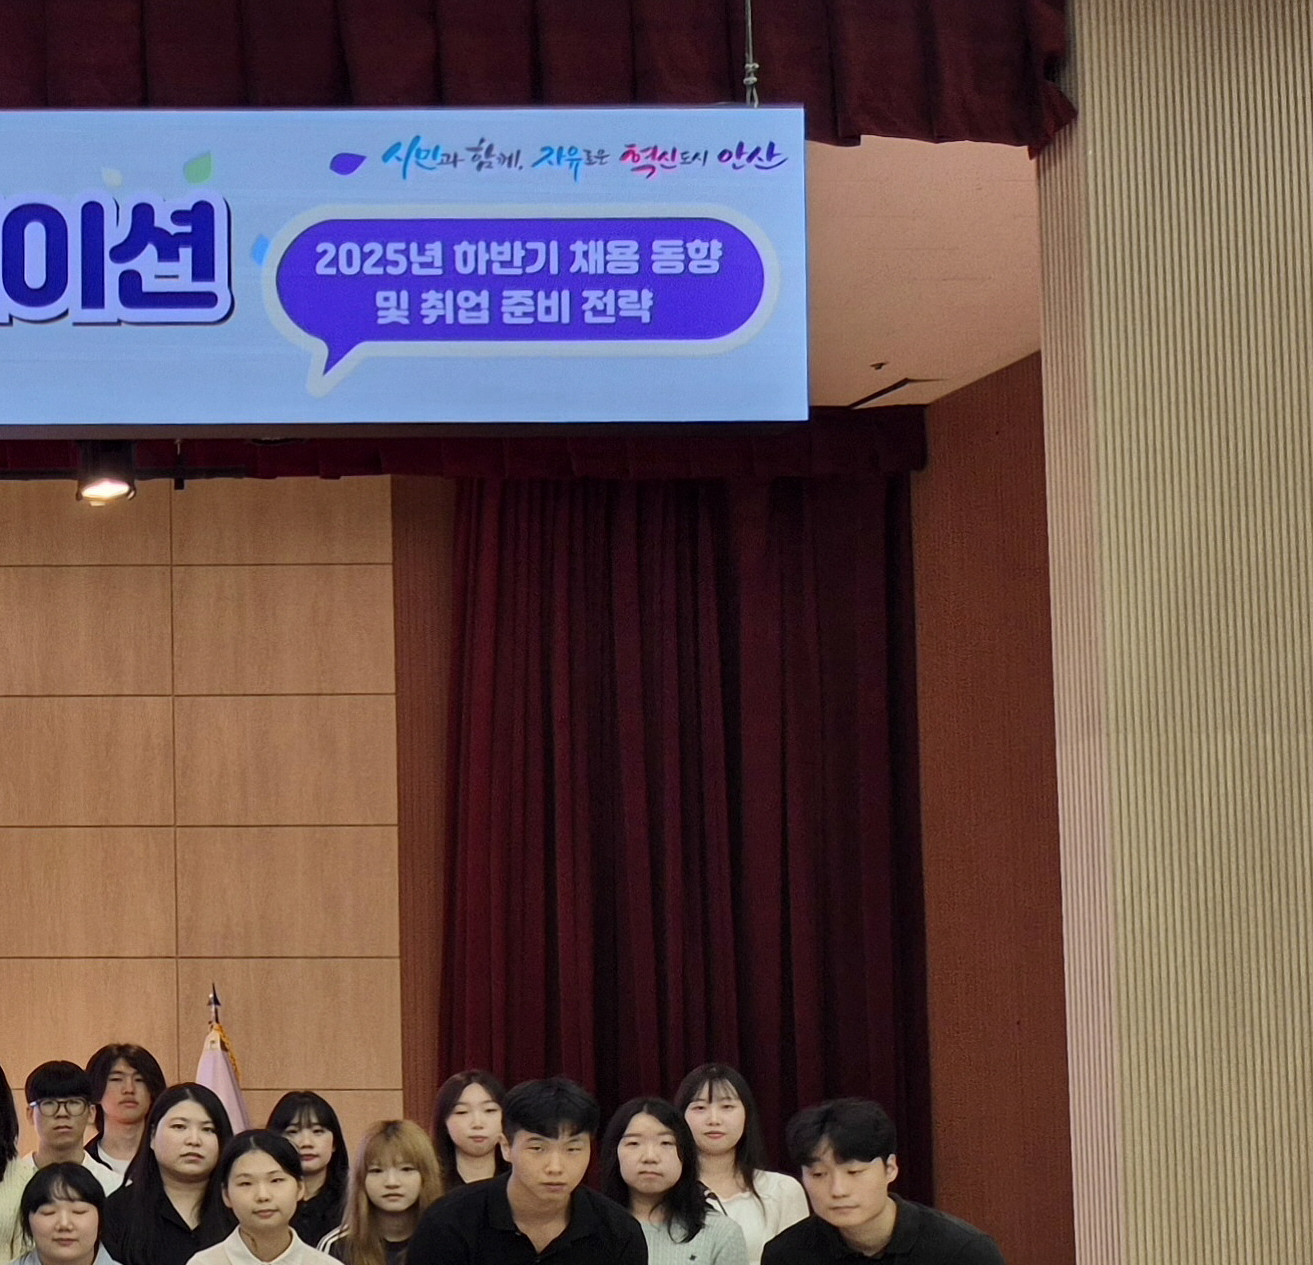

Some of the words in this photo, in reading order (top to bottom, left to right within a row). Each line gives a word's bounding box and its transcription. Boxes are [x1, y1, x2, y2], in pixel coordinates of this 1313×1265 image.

[619, 143, 707, 178] 혁신도시
[717, 141, 789, 169] 안산
[315, 239, 444, 278] 2025년
[453, 239, 559, 278] 하반기
[569, 239, 643, 278] 채용
[653, 239, 723, 278] 동향
[374, 289, 409, 326] 및
[419, 289, 491, 326] 취업
[503, 289, 571, 326] 준비
[583, 289, 653, 326] 전략
